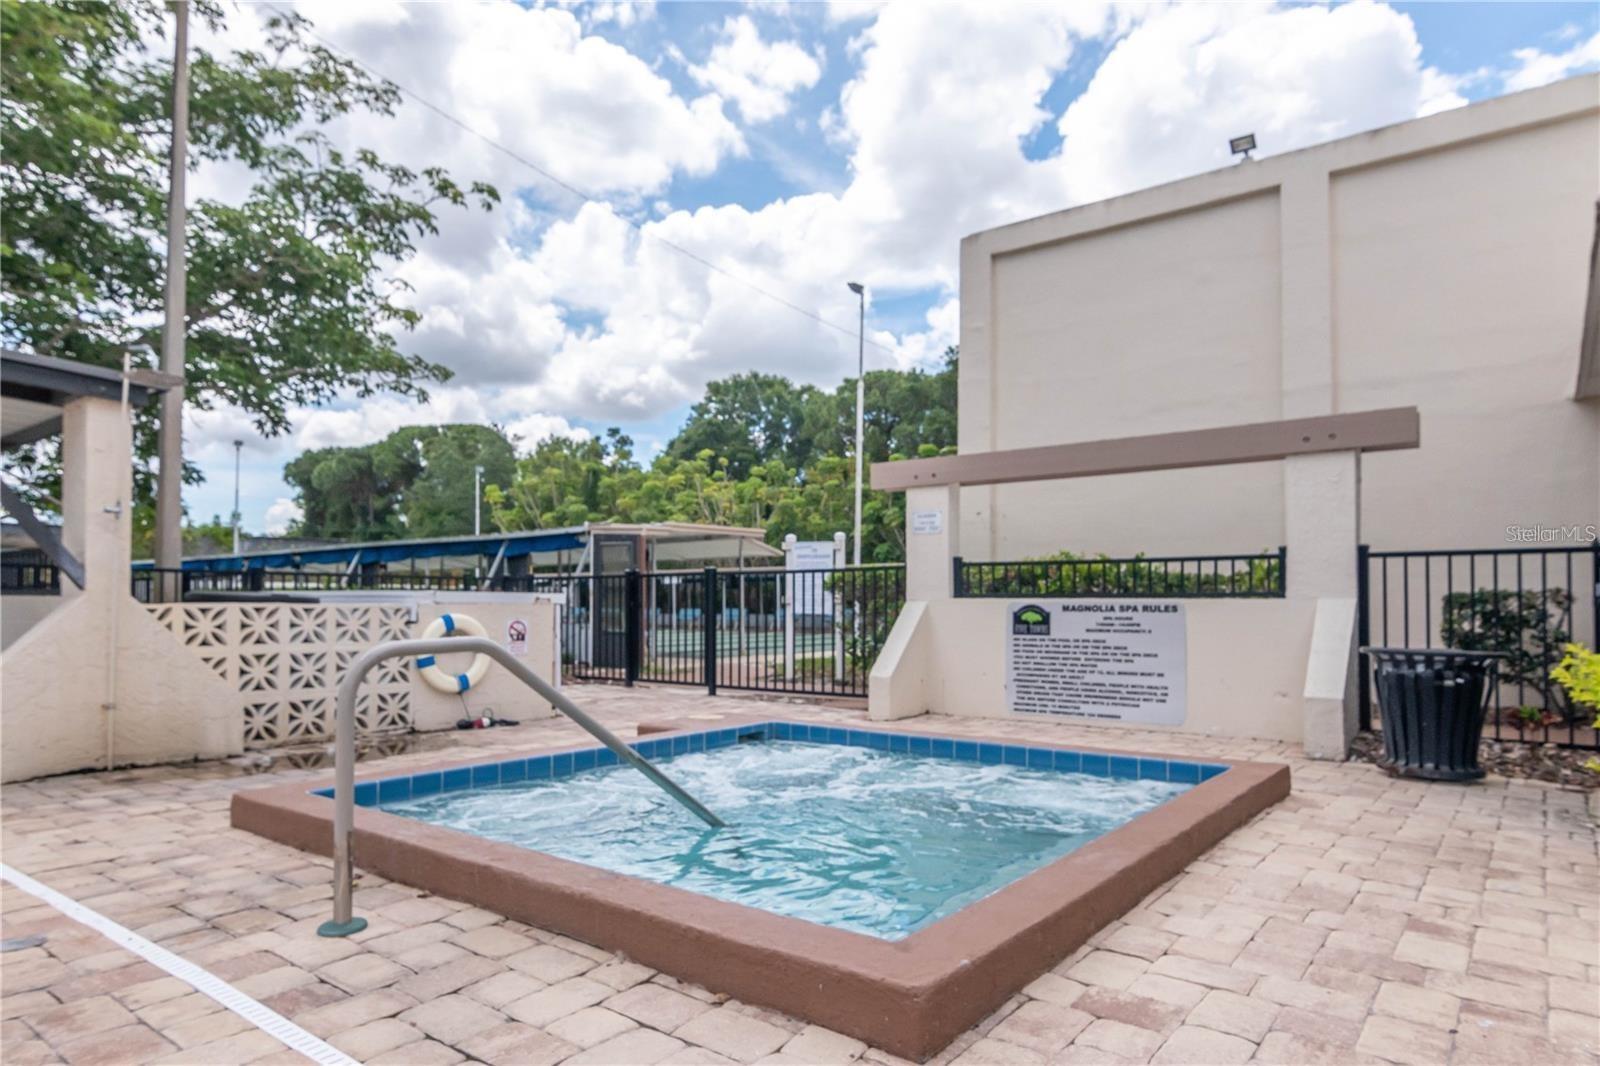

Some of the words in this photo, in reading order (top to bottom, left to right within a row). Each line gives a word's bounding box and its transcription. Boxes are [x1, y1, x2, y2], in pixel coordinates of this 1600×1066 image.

[1062, 604, 1116, 613] MAGNOLIA
[1119, 604, 1139, 613] SPA
[1142, 604, 1178, 613] RULES
